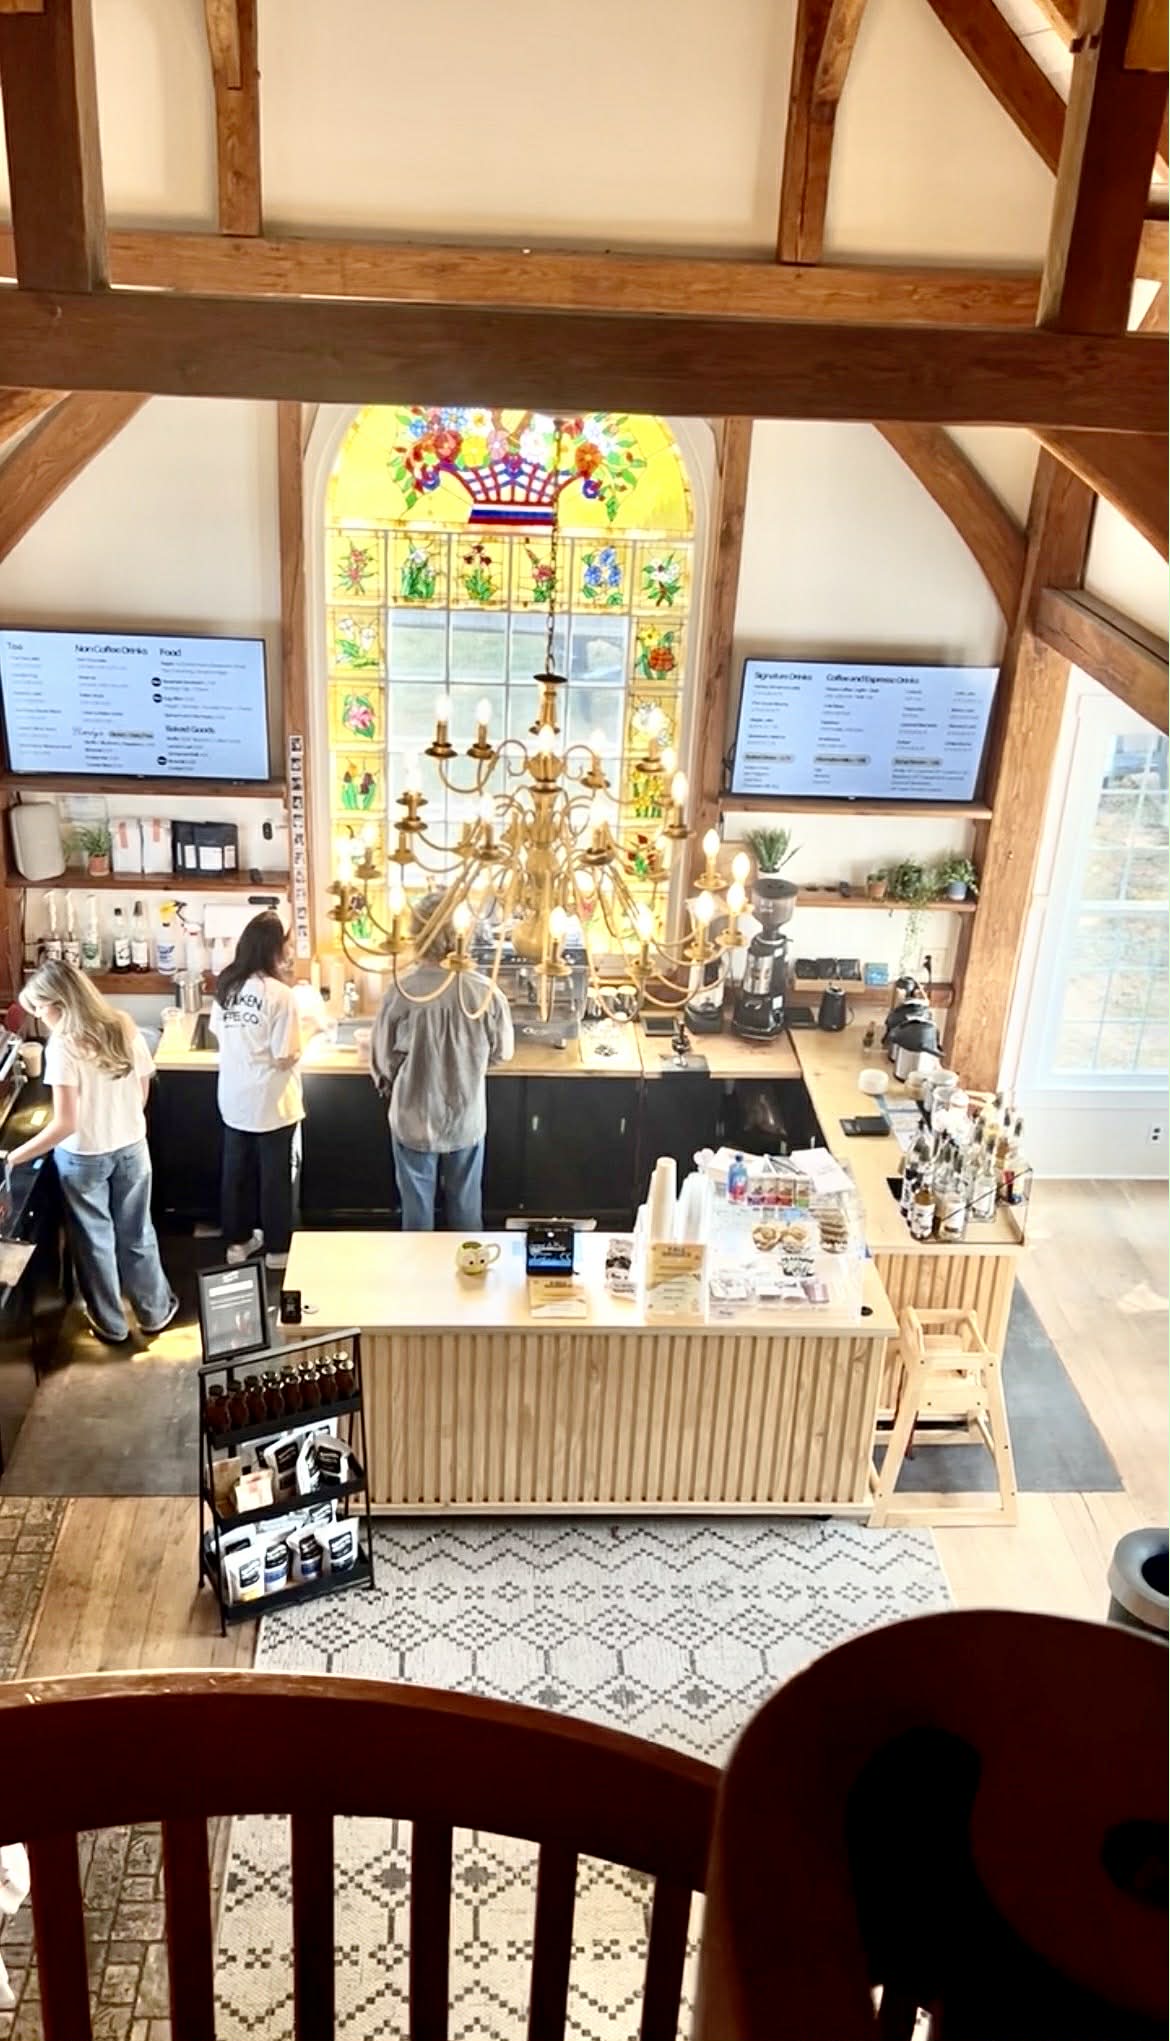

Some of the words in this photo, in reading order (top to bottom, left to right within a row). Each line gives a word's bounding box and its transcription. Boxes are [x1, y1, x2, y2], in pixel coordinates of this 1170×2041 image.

[94, 645, 120, 653] Coffee
[121, 646, 148, 655] Drinks
[160, 648, 181, 656] Food
[755, 671, 788, 681] Signature
[790, 673, 812, 681] Drinks
[826, 673, 851, 682] Coffee
[896, 676, 919, 684] Drinks
[191, 726, 215, 734] Goods
